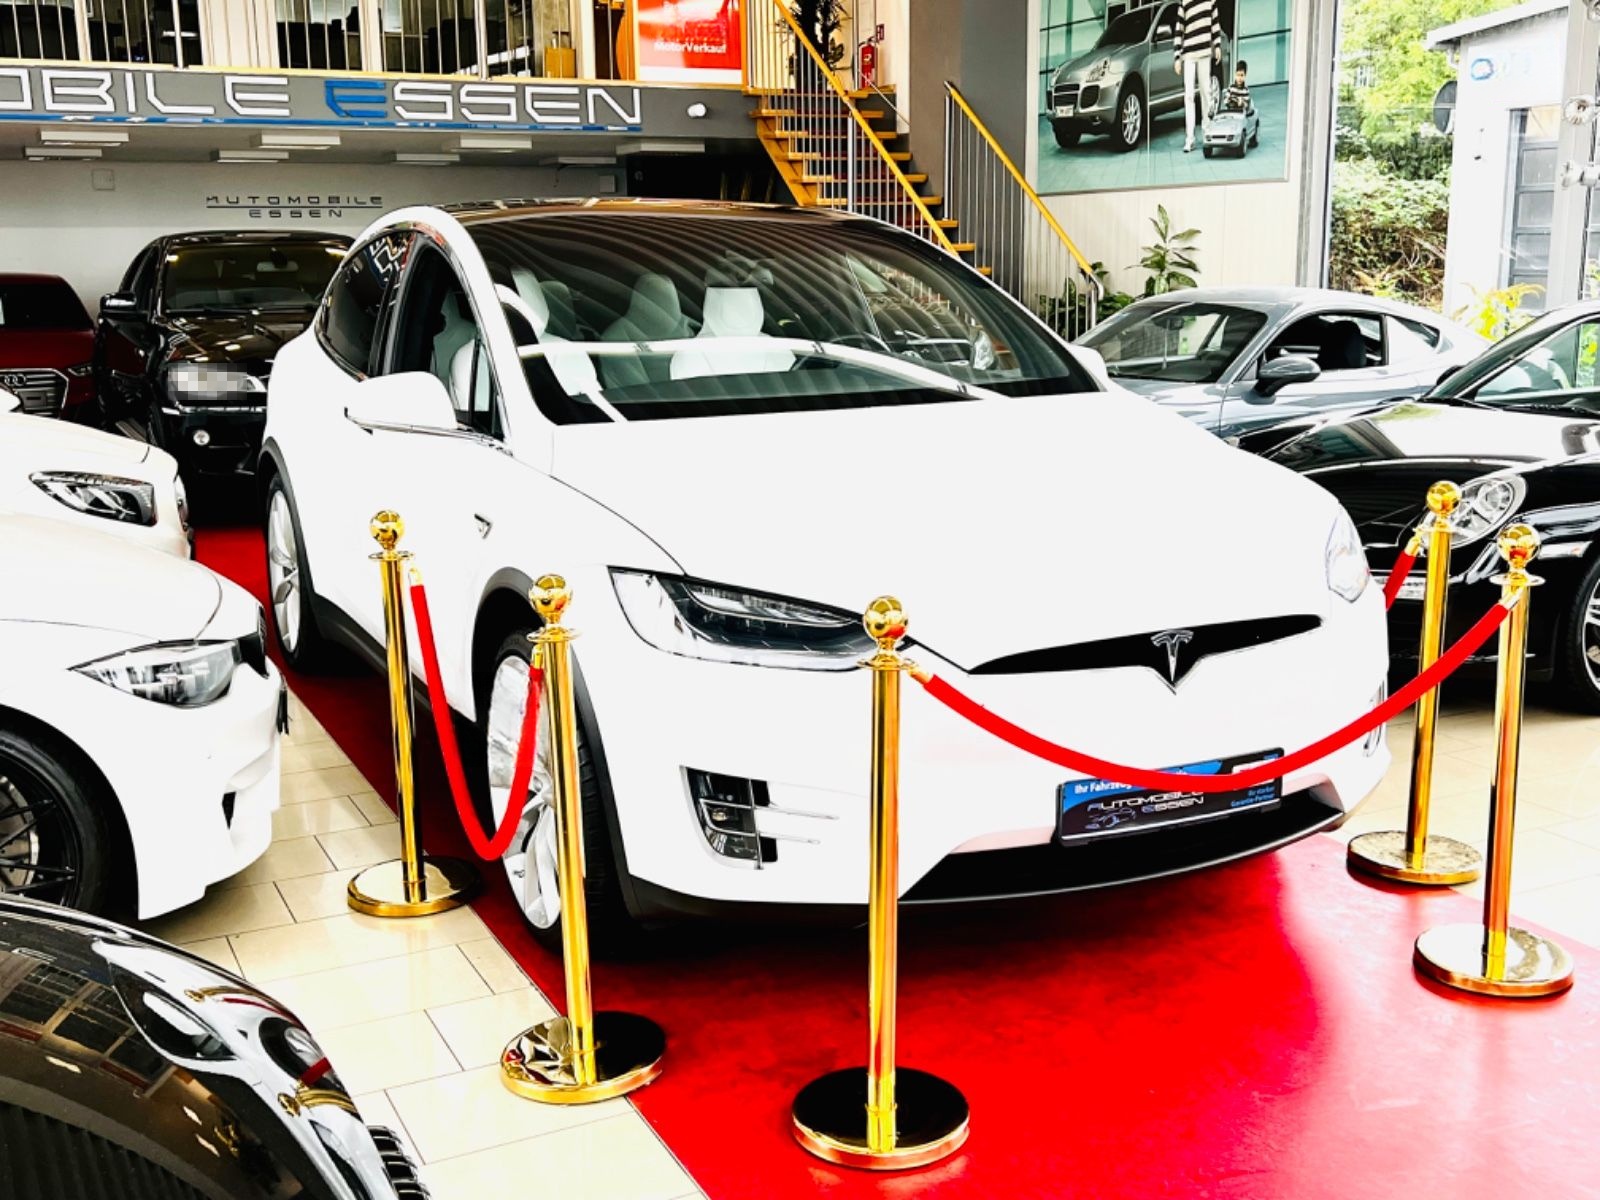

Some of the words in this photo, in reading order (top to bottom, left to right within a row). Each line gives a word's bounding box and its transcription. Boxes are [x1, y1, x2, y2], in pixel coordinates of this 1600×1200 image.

[324, 80, 642, 124] ESSEN
[206, 195, 383, 205] AUTOMOBILE
[248, 209, 342, 219] ESSEN
[1141, 797, 1204, 814] ESSEN
